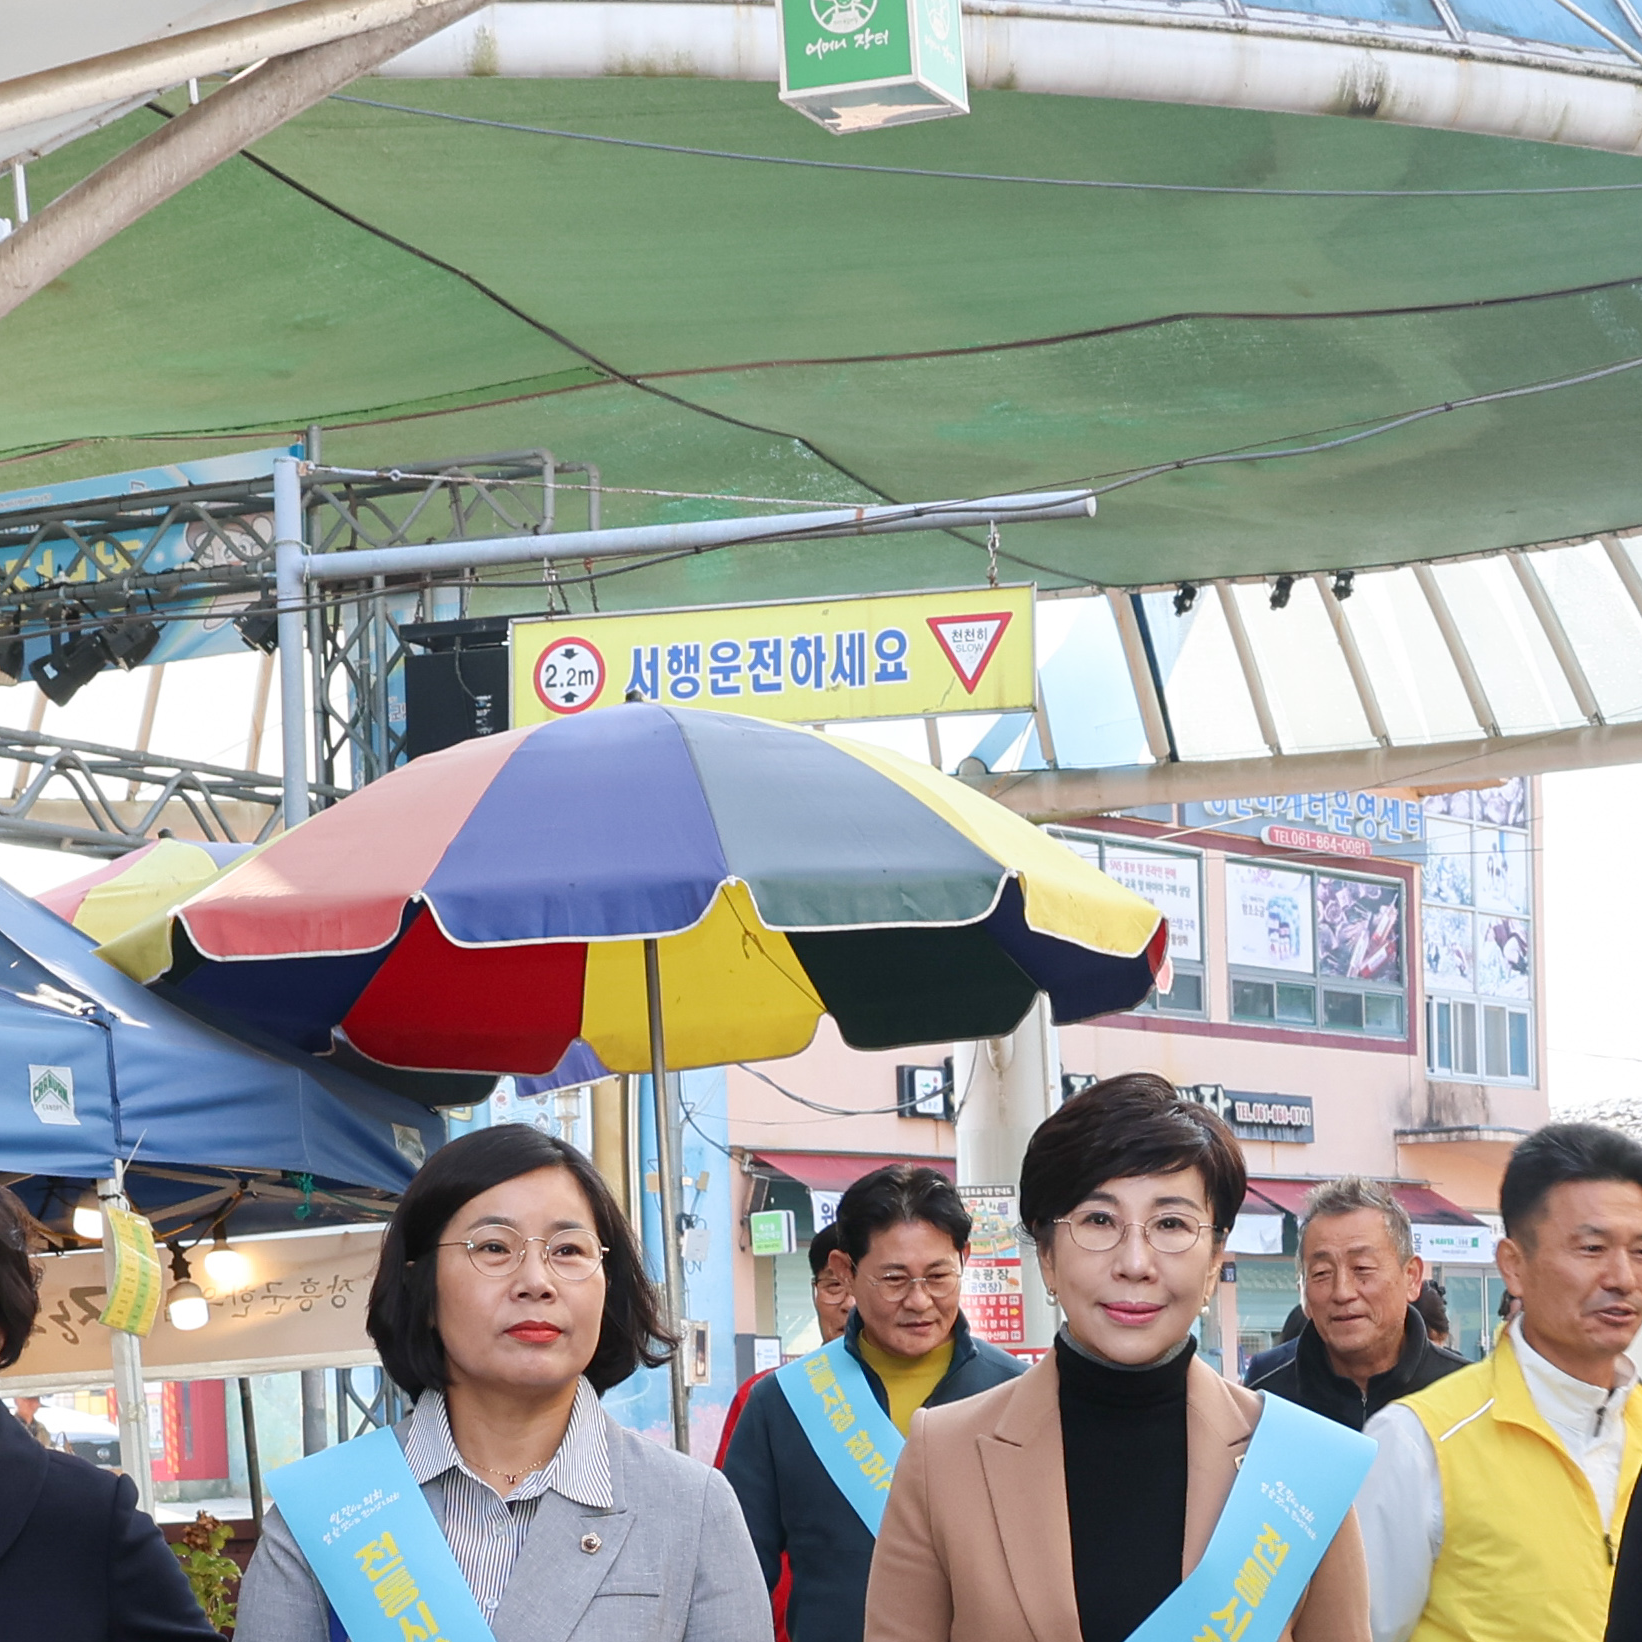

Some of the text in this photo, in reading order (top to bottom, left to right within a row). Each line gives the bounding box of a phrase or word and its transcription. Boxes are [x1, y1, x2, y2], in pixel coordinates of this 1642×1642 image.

[951, 625, 988, 644] 천천히
[955, 641, 986, 654] SLOW
[625, 627, 910, 701] 서행운전하세요
[544, 662, 596, 690] 2.2m
